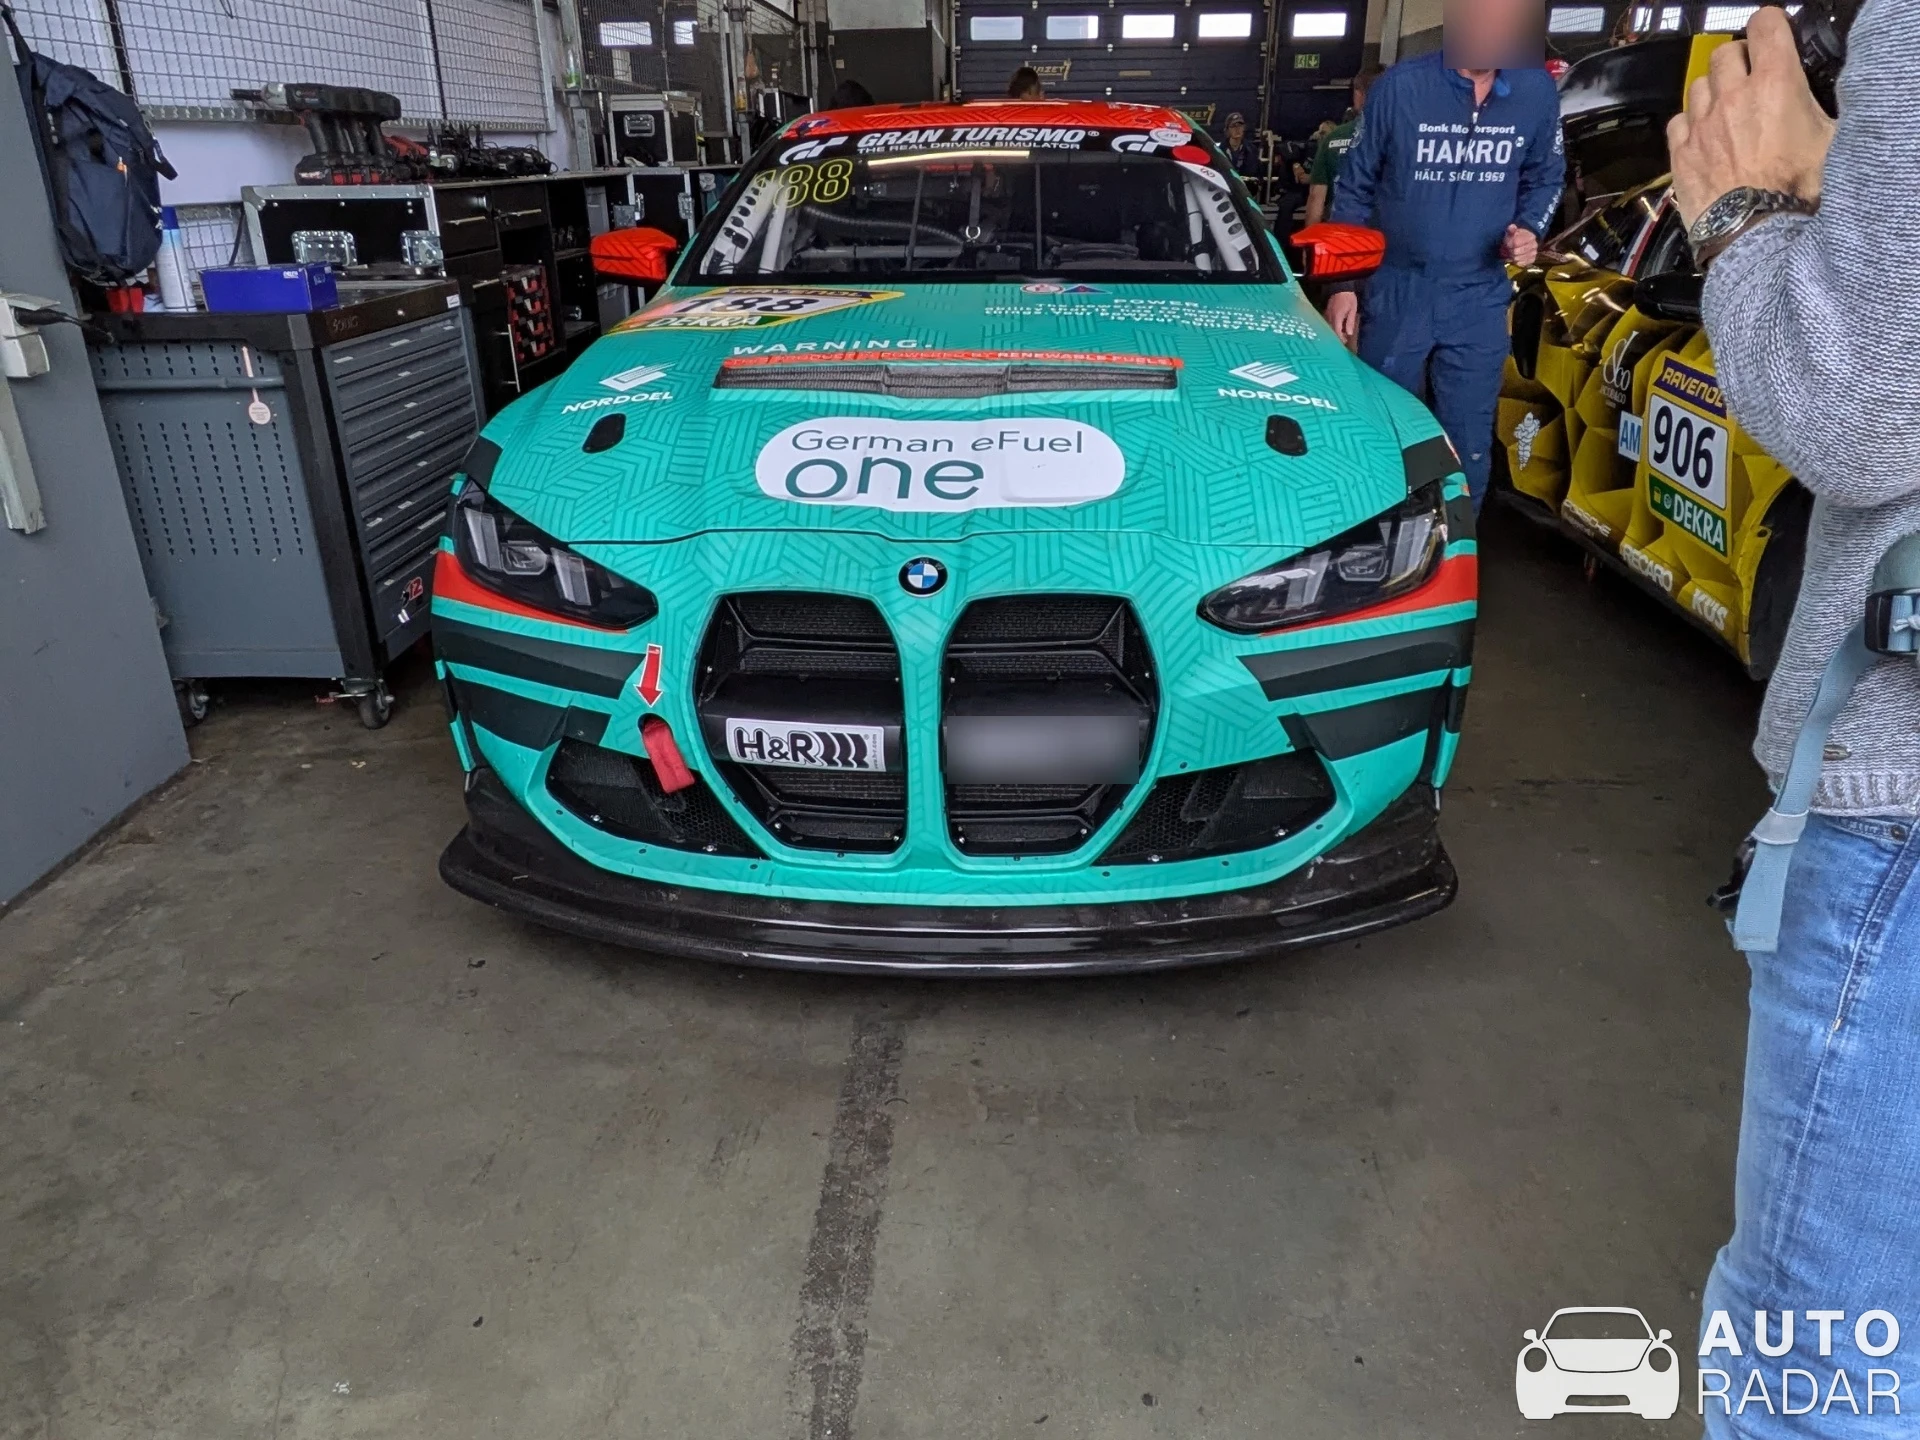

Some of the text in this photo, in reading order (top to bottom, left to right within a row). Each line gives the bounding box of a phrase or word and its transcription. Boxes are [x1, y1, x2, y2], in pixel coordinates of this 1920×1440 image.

[857, 128, 945, 147] GRAN
[1418, 123, 1448, 133] Bonk
[889, 144, 928, 152] REAL
[930, 141, 991, 149] DRIVING
[994, 141, 1080, 149] SIMULATOR
[673, 297, 820, 313] 188
[647, 316, 762, 328] DEKRA
[733, 339, 932, 355] WARNING.
[997, 352, 1108, 361] RENEWABLE
[561, 392, 673, 414] NORDOEL
[1218, 388, 1338, 411] NORDOEL
[791, 430, 1083, 453] German eFuel
[1653, 405, 1716, 489] 906
[784, 456, 985, 500] one
[1673, 493, 1725, 552] DEKRA
[1622, 545, 1674, 592] RECARO
